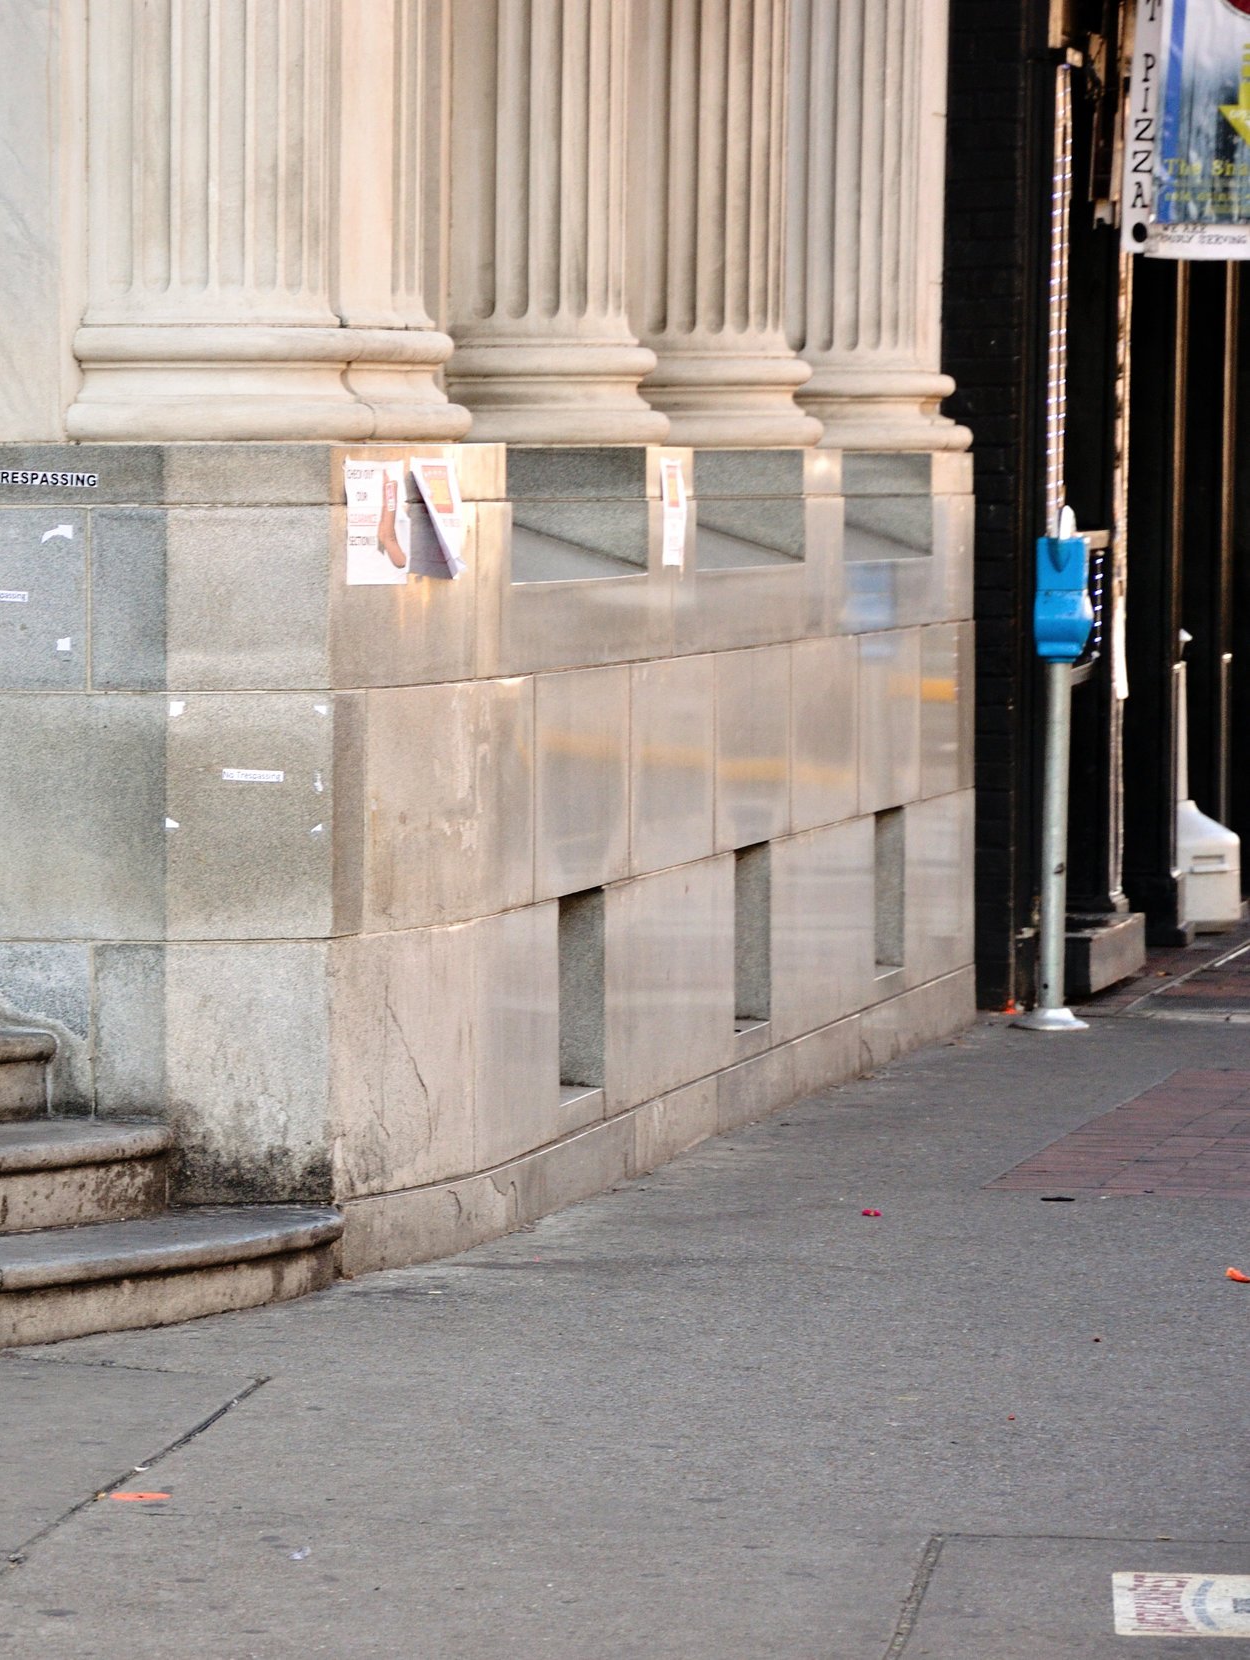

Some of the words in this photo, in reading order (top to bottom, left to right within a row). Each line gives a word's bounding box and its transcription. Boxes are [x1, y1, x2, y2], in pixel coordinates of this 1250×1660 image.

[1131, 53, 1156, 208] PIZZA
[222, 770, 235, 779] No
[236, 771, 282, 782] Trespassing
